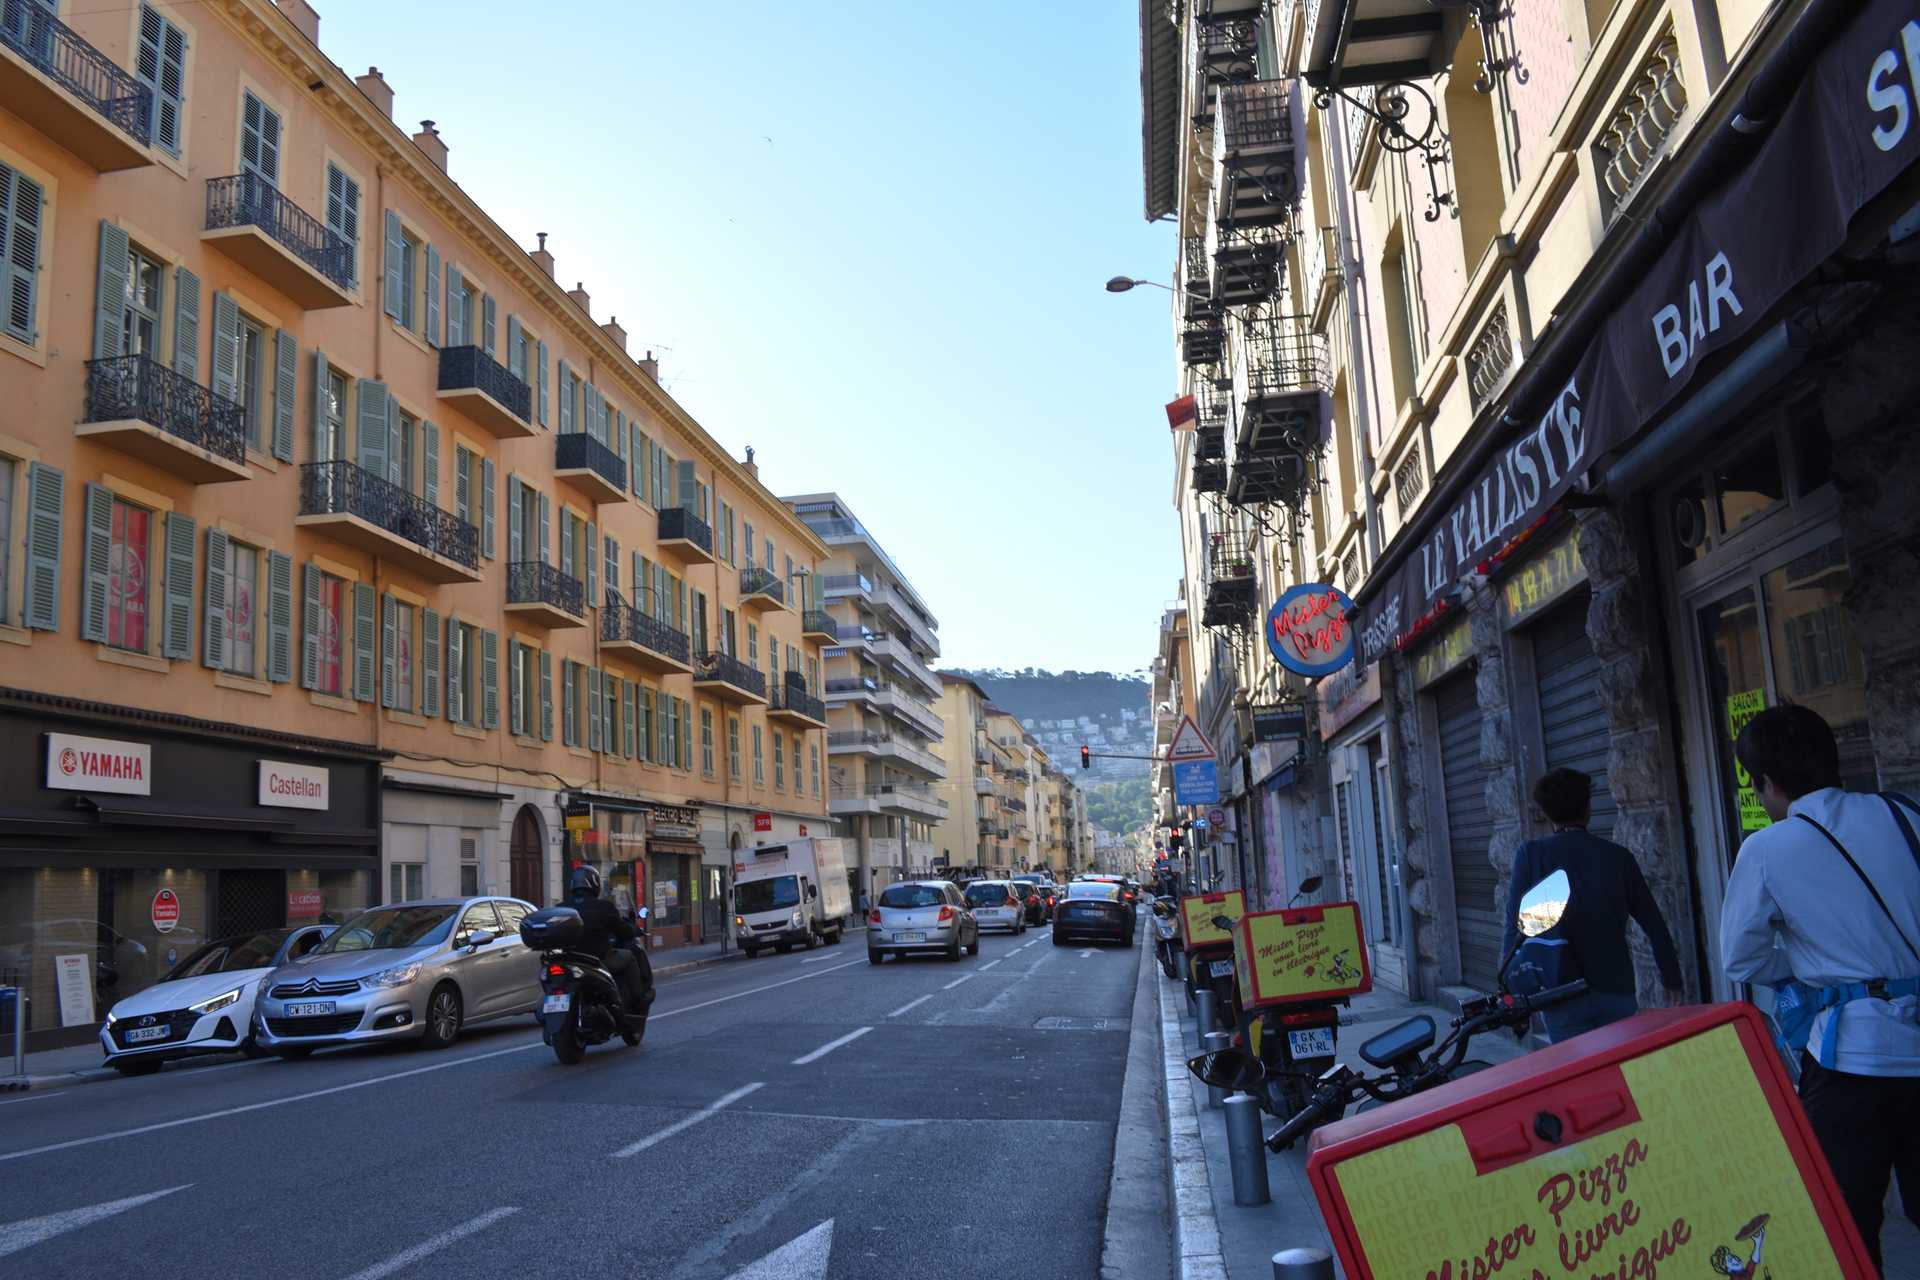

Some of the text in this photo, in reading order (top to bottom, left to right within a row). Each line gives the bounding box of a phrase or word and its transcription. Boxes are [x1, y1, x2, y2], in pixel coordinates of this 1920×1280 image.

[1422, 529, 1449, 600] LE
[1451, 377, 1585, 566] VALLISTE
[1651, 250, 1744, 379] BAR
[1272, 589, 1340, 641] Mister
[1293, 609, 1349, 659] Pizza
[80, 751, 143, 781] YAMAHA
[269, 773, 321, 798] Castellan
[1258, 925, 1324, 959] Mister Pizza
[1298, 939, 1319, 953] livre
[1300, 1031, 1316, 1042] GK
[1538, 1138, 1648, 1227] Pizza
[1558, 1199, 1640, 1272] livre
